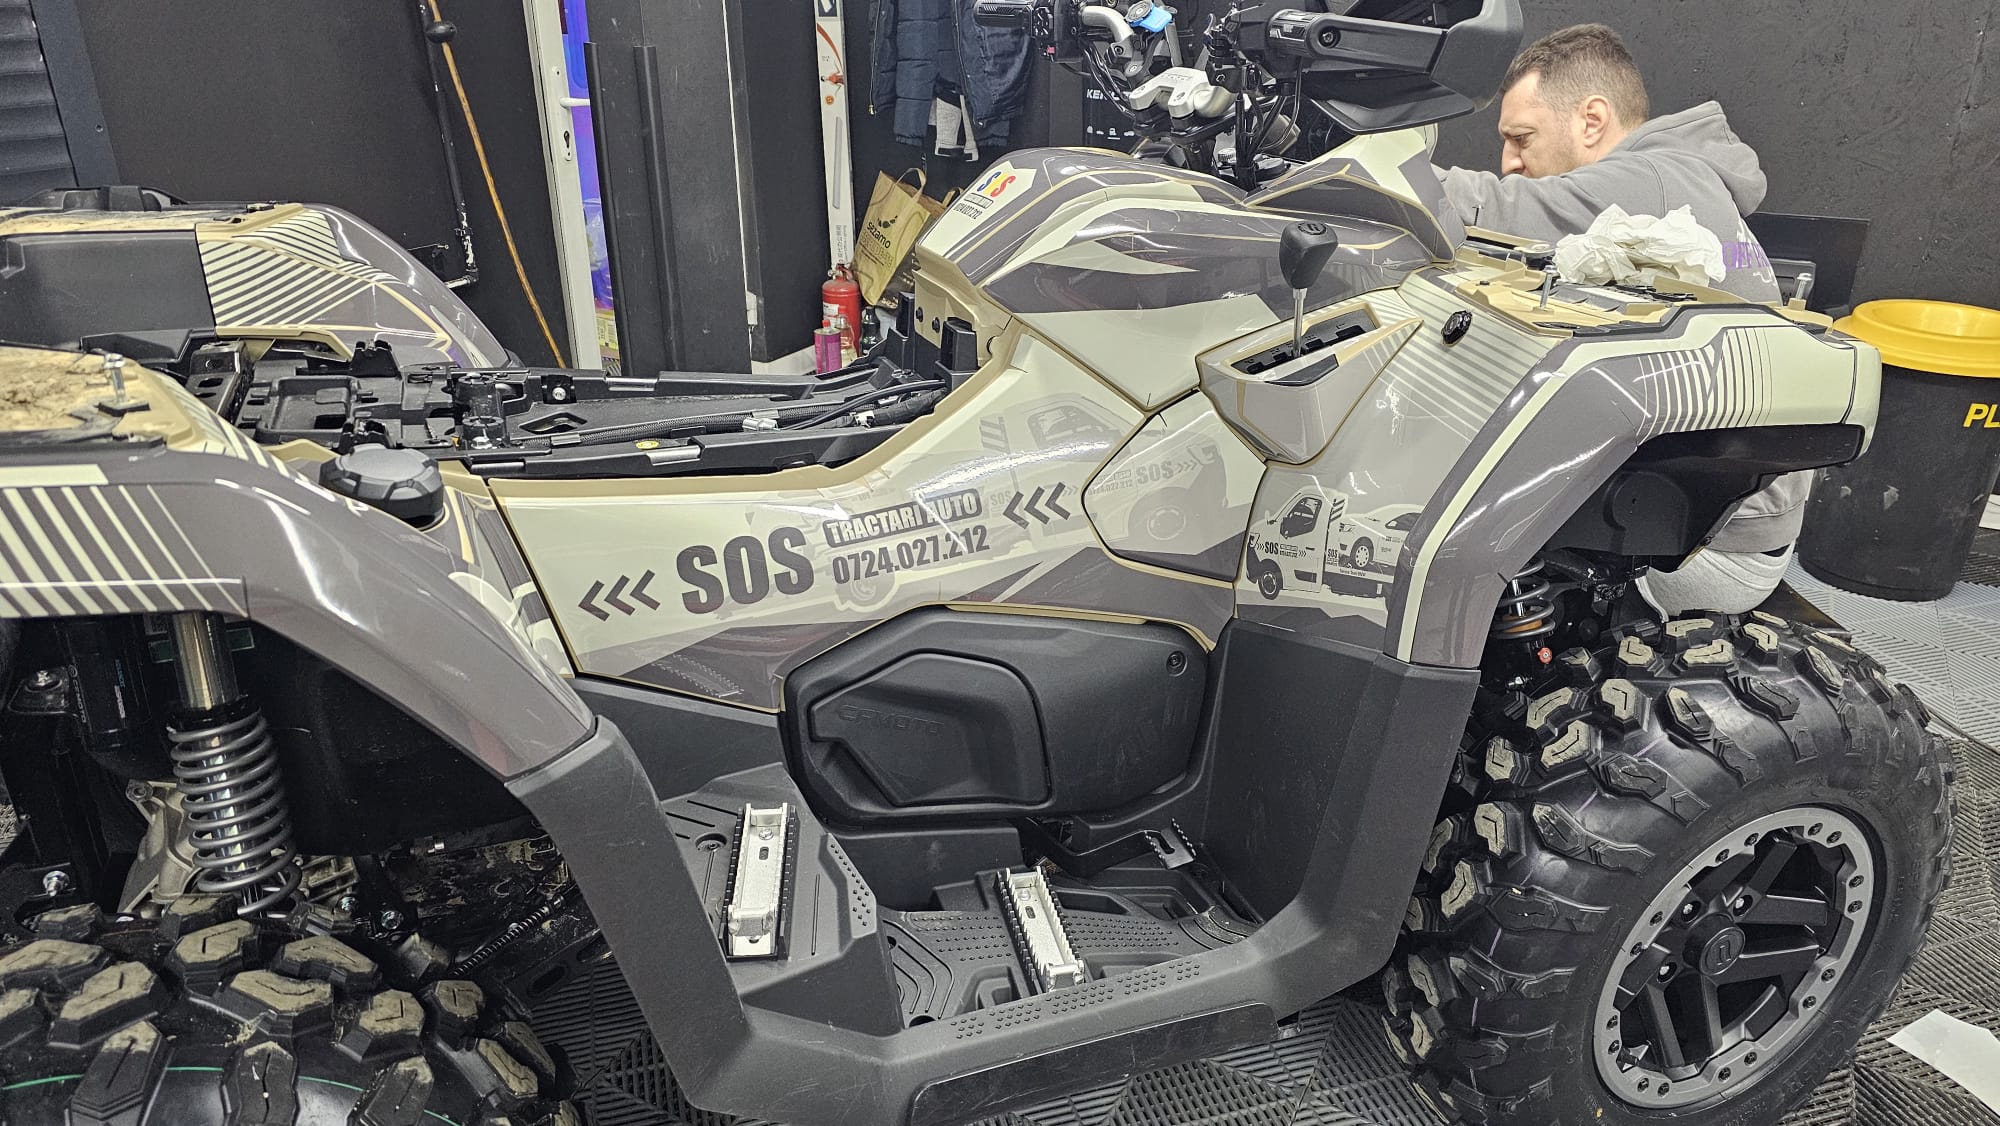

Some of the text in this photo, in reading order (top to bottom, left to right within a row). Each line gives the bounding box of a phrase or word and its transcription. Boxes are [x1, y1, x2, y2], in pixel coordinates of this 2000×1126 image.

[867, 221, 891, 249] sezamo
[1136, 461, 1175, 486] SOS
[827, 490, 979, 542] TRACTARI AUTO
[832, 524, 990, 585] 0724.027.212
[1264, 541, 1279, 555] SOS
[1327, 548, 1338, 559] SOS
[676, 527, 815, 615] SOS
[841, 704, 945, 733] CFMOTO
